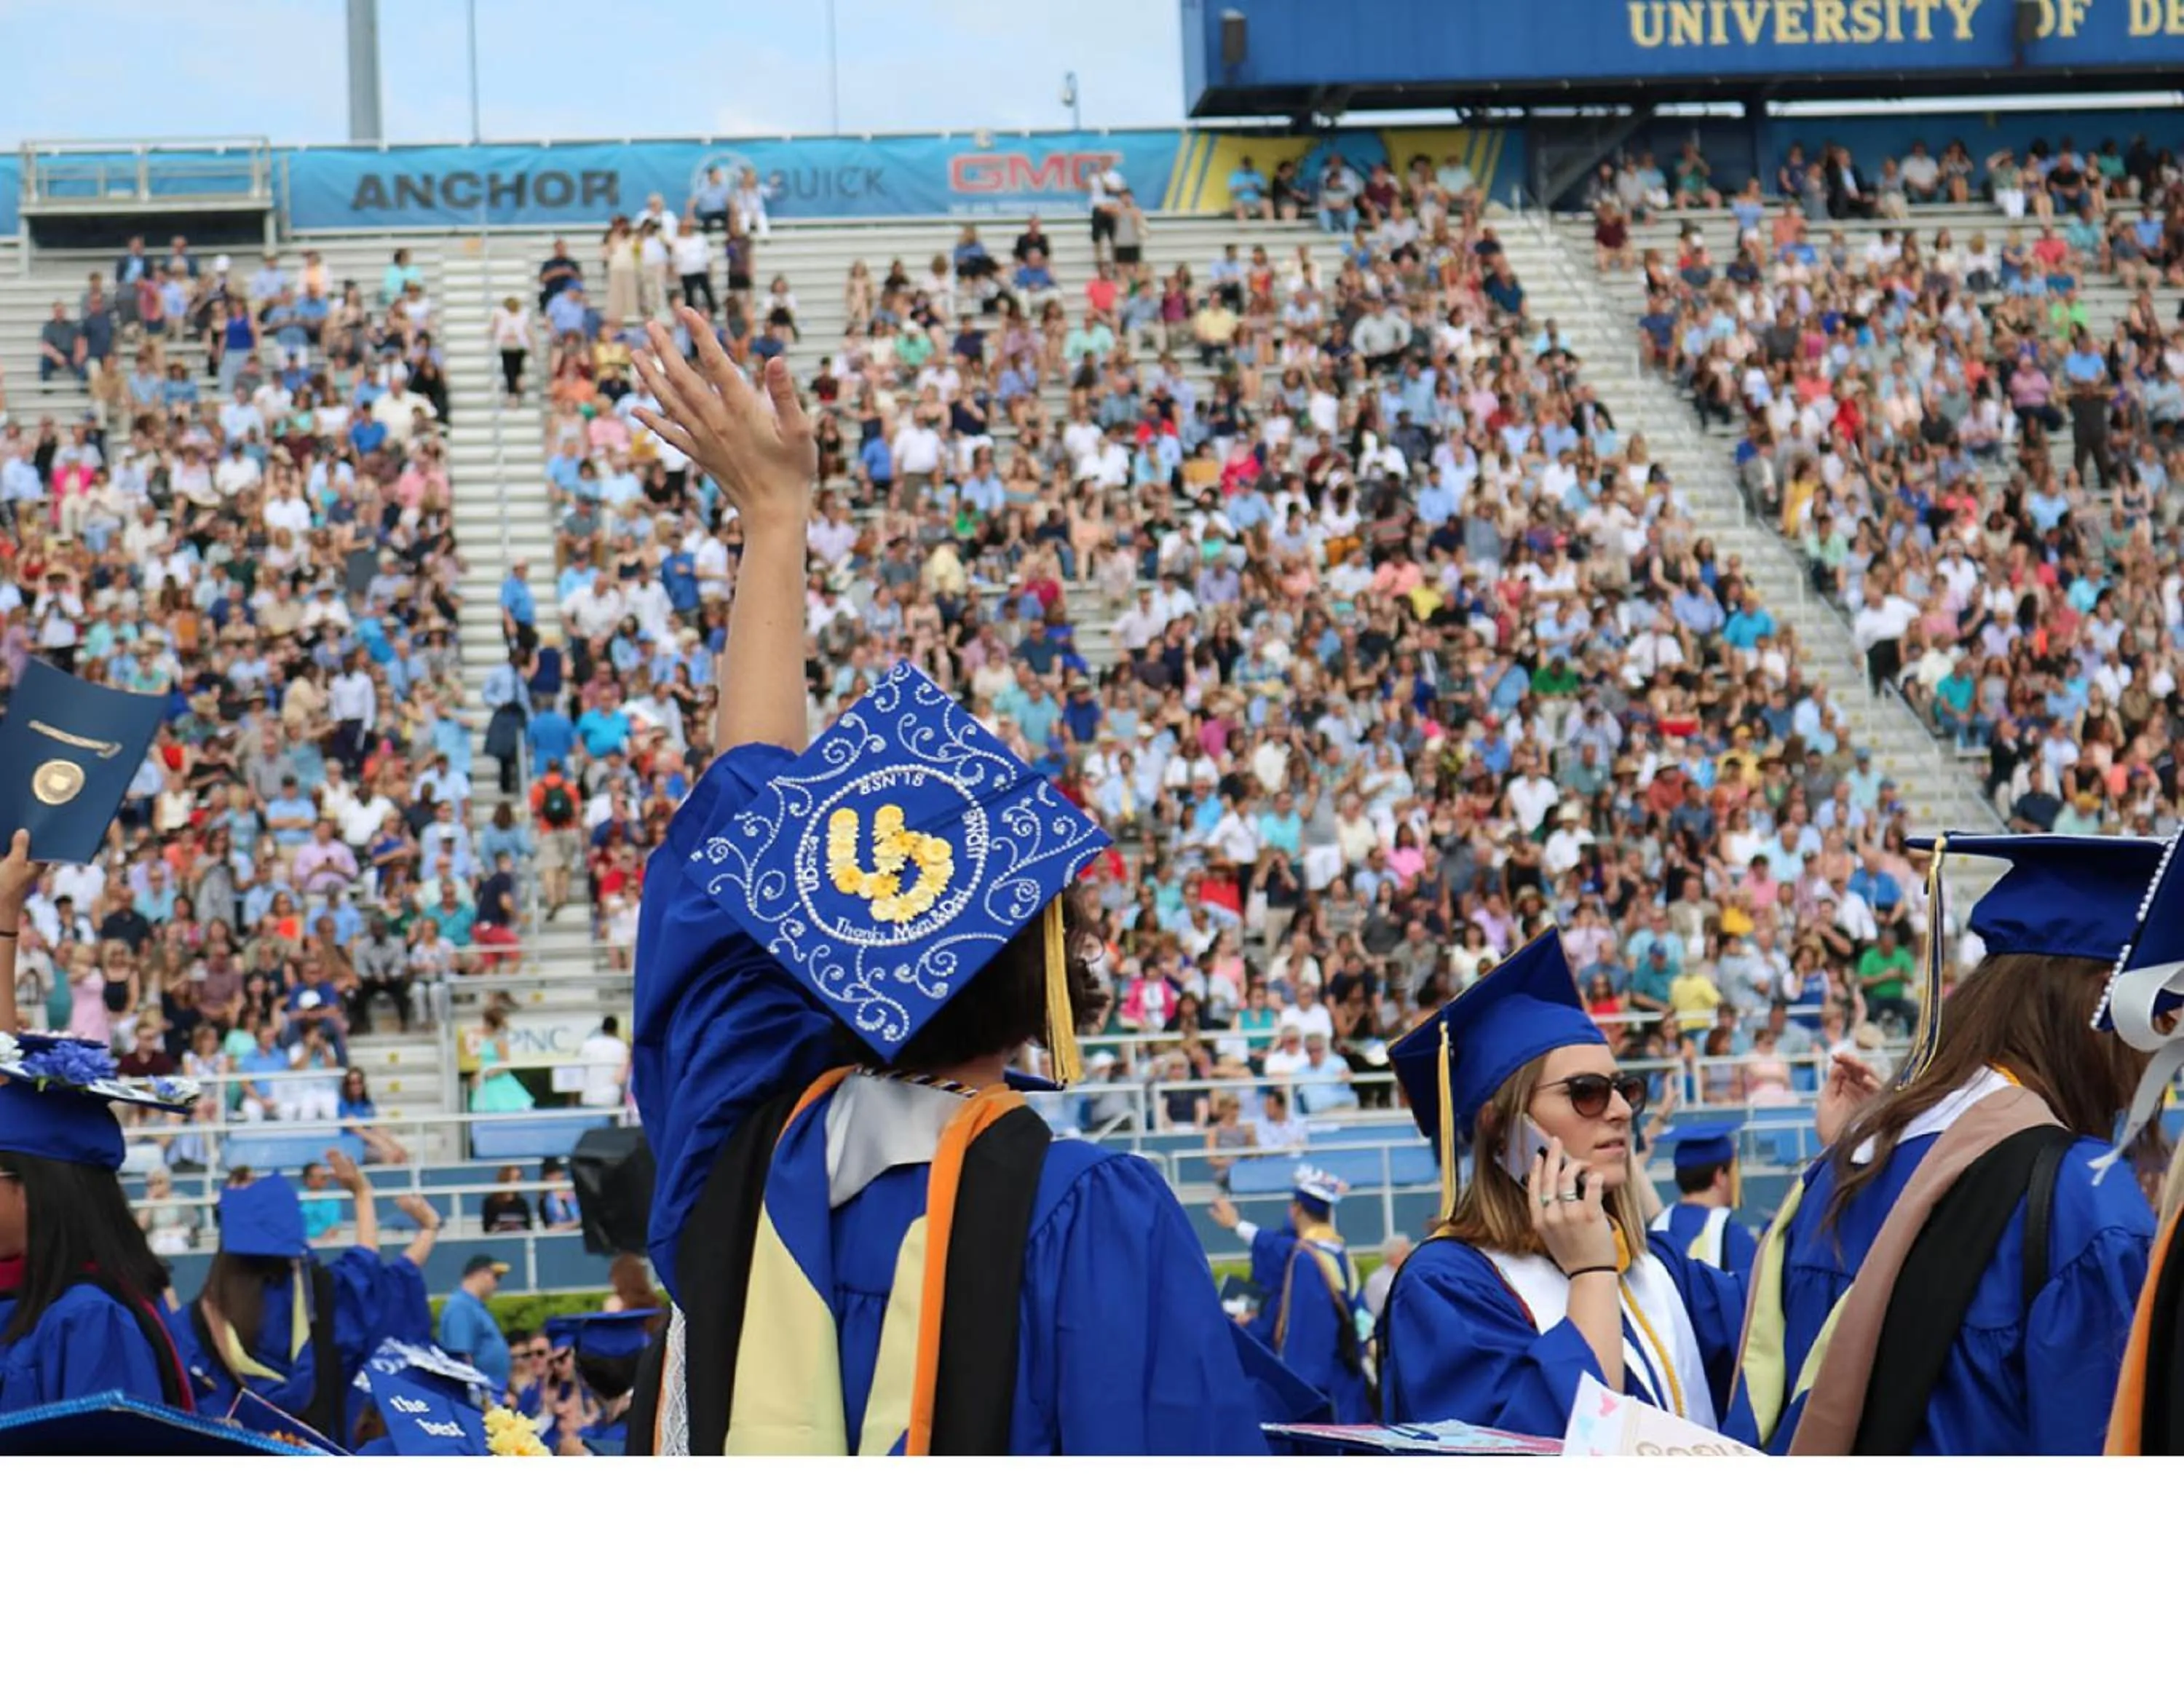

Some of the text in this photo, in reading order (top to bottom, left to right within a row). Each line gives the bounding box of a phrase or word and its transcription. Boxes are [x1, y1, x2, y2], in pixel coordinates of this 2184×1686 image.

[1629, 0, 1975, 47] UNIVERSITY
[350, 169, 622, 211] ANCHOR
[769, 166, 888, 202] BUICK
[951, 151, 1122, 193] GMC
[389, 1396, 430, 1412] the
[415, 1418, 466, 1437] best
